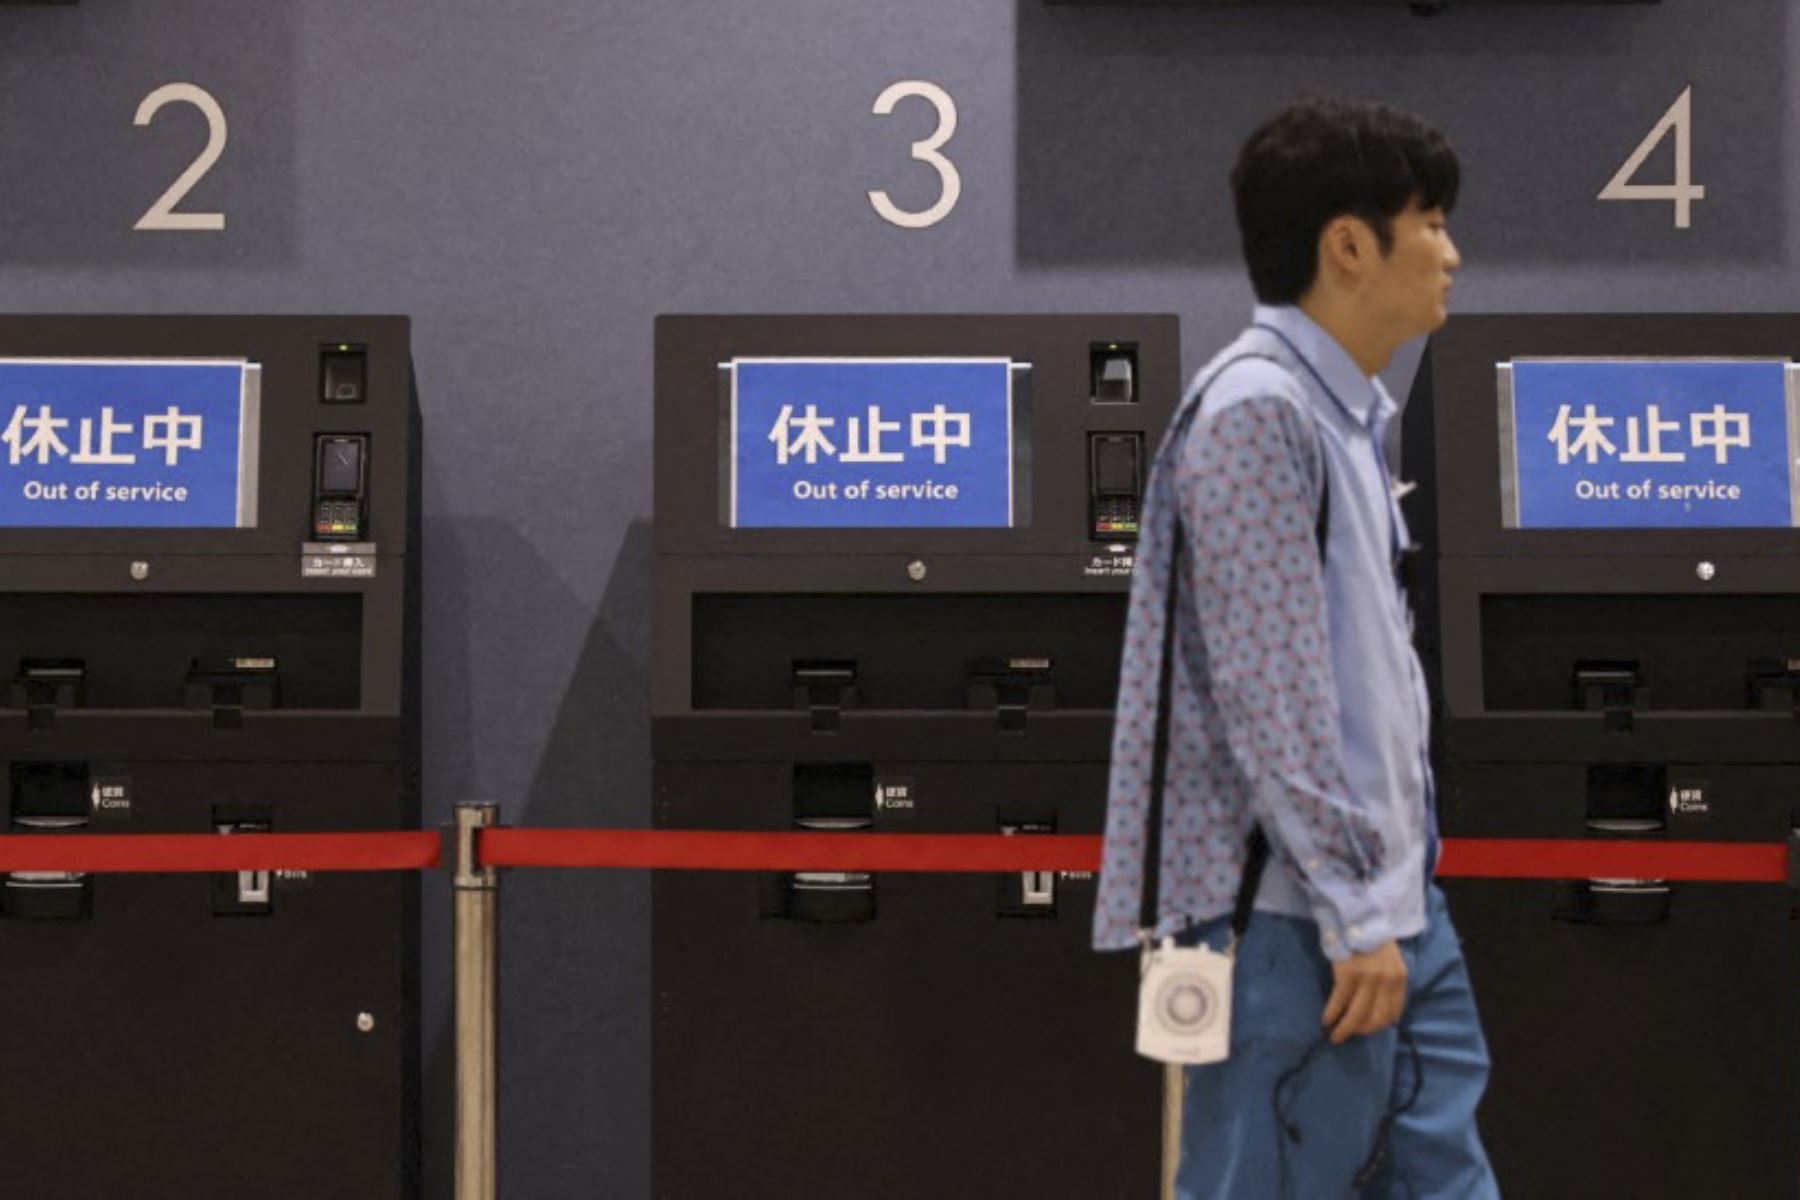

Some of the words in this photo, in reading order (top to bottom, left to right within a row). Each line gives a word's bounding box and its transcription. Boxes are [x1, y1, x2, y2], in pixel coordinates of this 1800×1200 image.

[134, 82, 227, 231] 2
[867, 79, 962, 229] 3
[1597, 84, 1706, 229] 4
[1, 404, 204, 466] 休止中
[767, 403, 972, 466] 休止中
[1546, 403, 1752, 466] 休止中
[23, 481, 68, 501] Out
[74, 480, 100, 501] of
[105, 481, 188, 501] service
[792, 480, 838, 500] Out
[843, 479, 870, 500] of
[875, 480, 959, 500] service
[1575, 480, 1620, 500] Out
[1625, 479, 1652, 500] of
[1658, 480, 1741, 500] service
